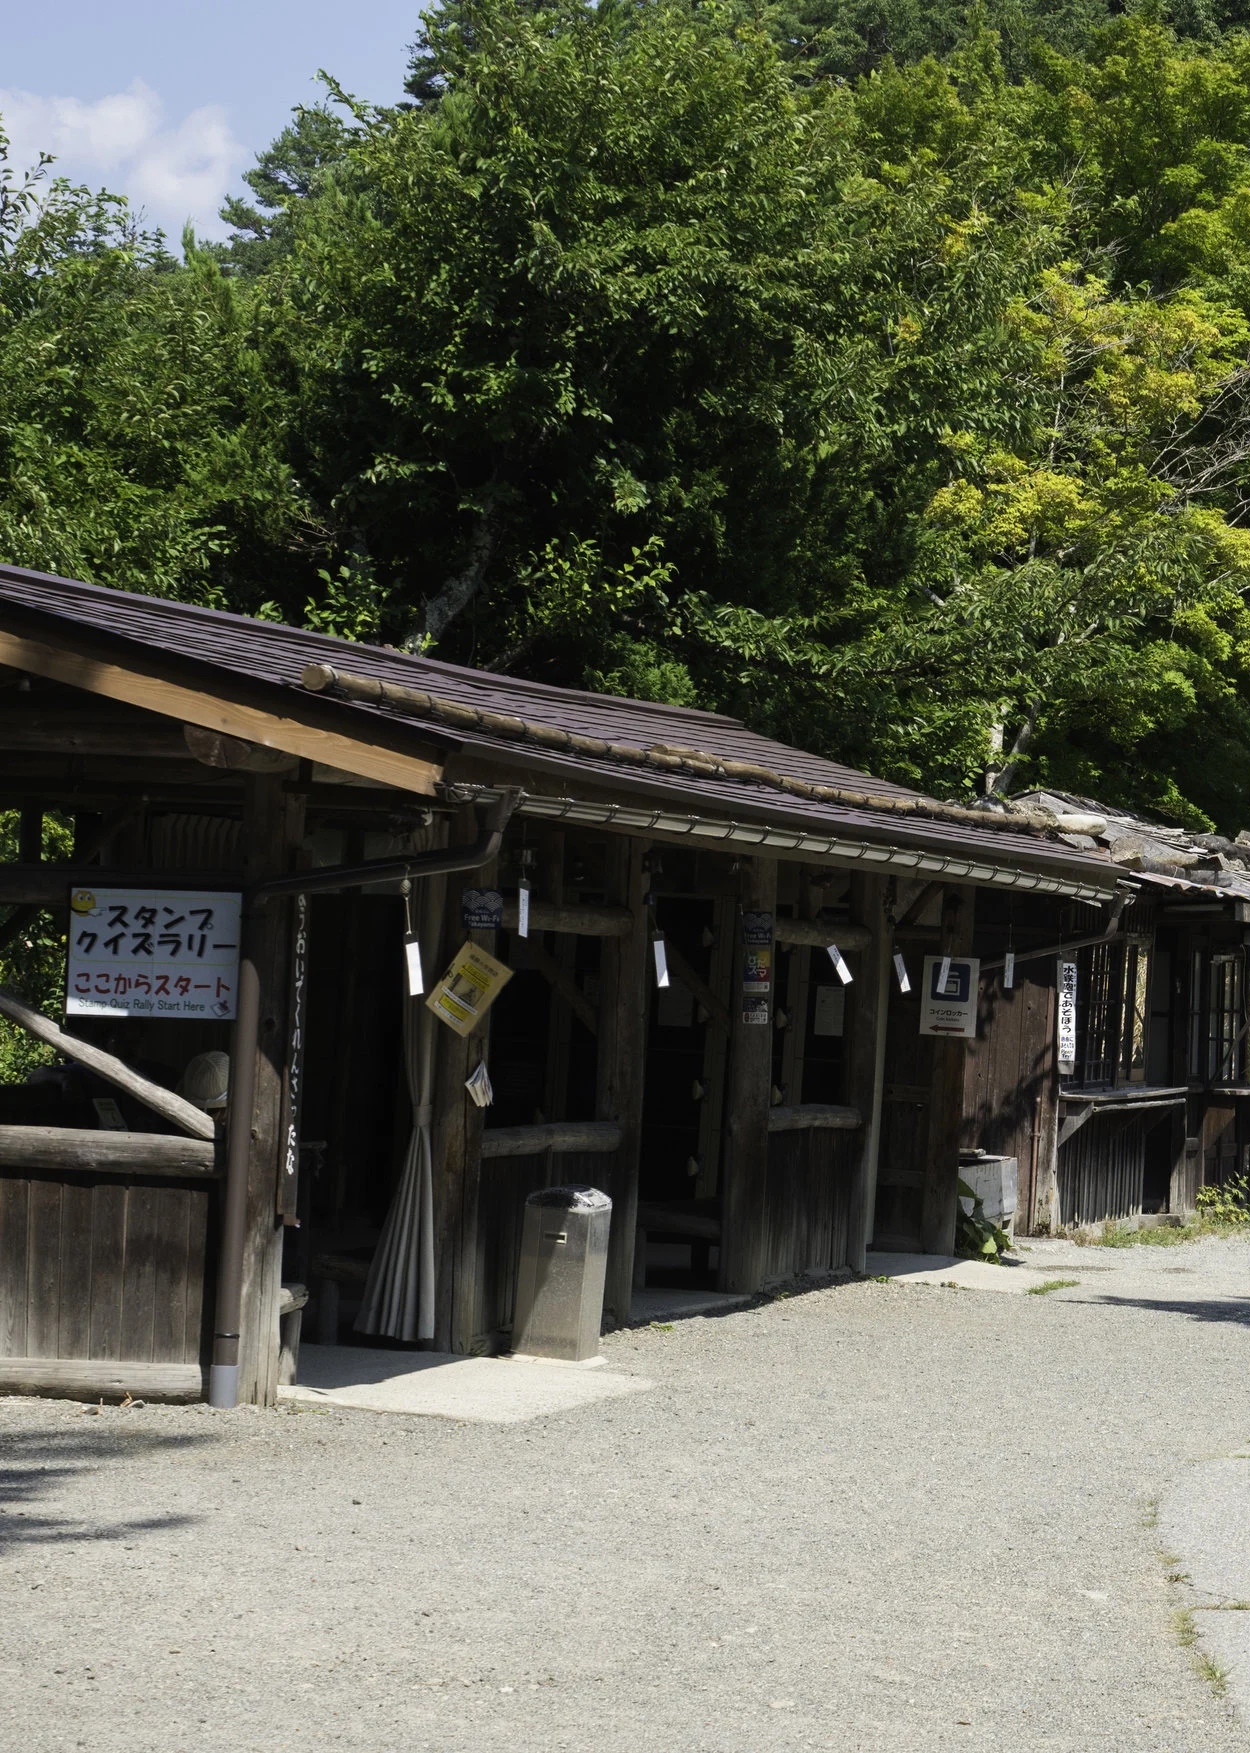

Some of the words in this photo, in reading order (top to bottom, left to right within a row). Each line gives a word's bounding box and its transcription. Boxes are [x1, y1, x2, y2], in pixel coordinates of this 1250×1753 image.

[107, 905, 214, 931] スタンプ
[463, 913, 480, 921] Free
[481, 914, 500, 922] Wi-Fi
[76, 930, 238, 957] クイズラリー
[74, 972, 232, 998] ここからスタート
[78, 997, 107, 1009] Stamp
[110, 998, 130, 1009] Quiz
[133, 998, 155, 1011] Rally
[157, 999, 180, 1011] Start
[183, 1000, 206, 1012] Here
[929, 1008, 968, 1017] コインロッカー
